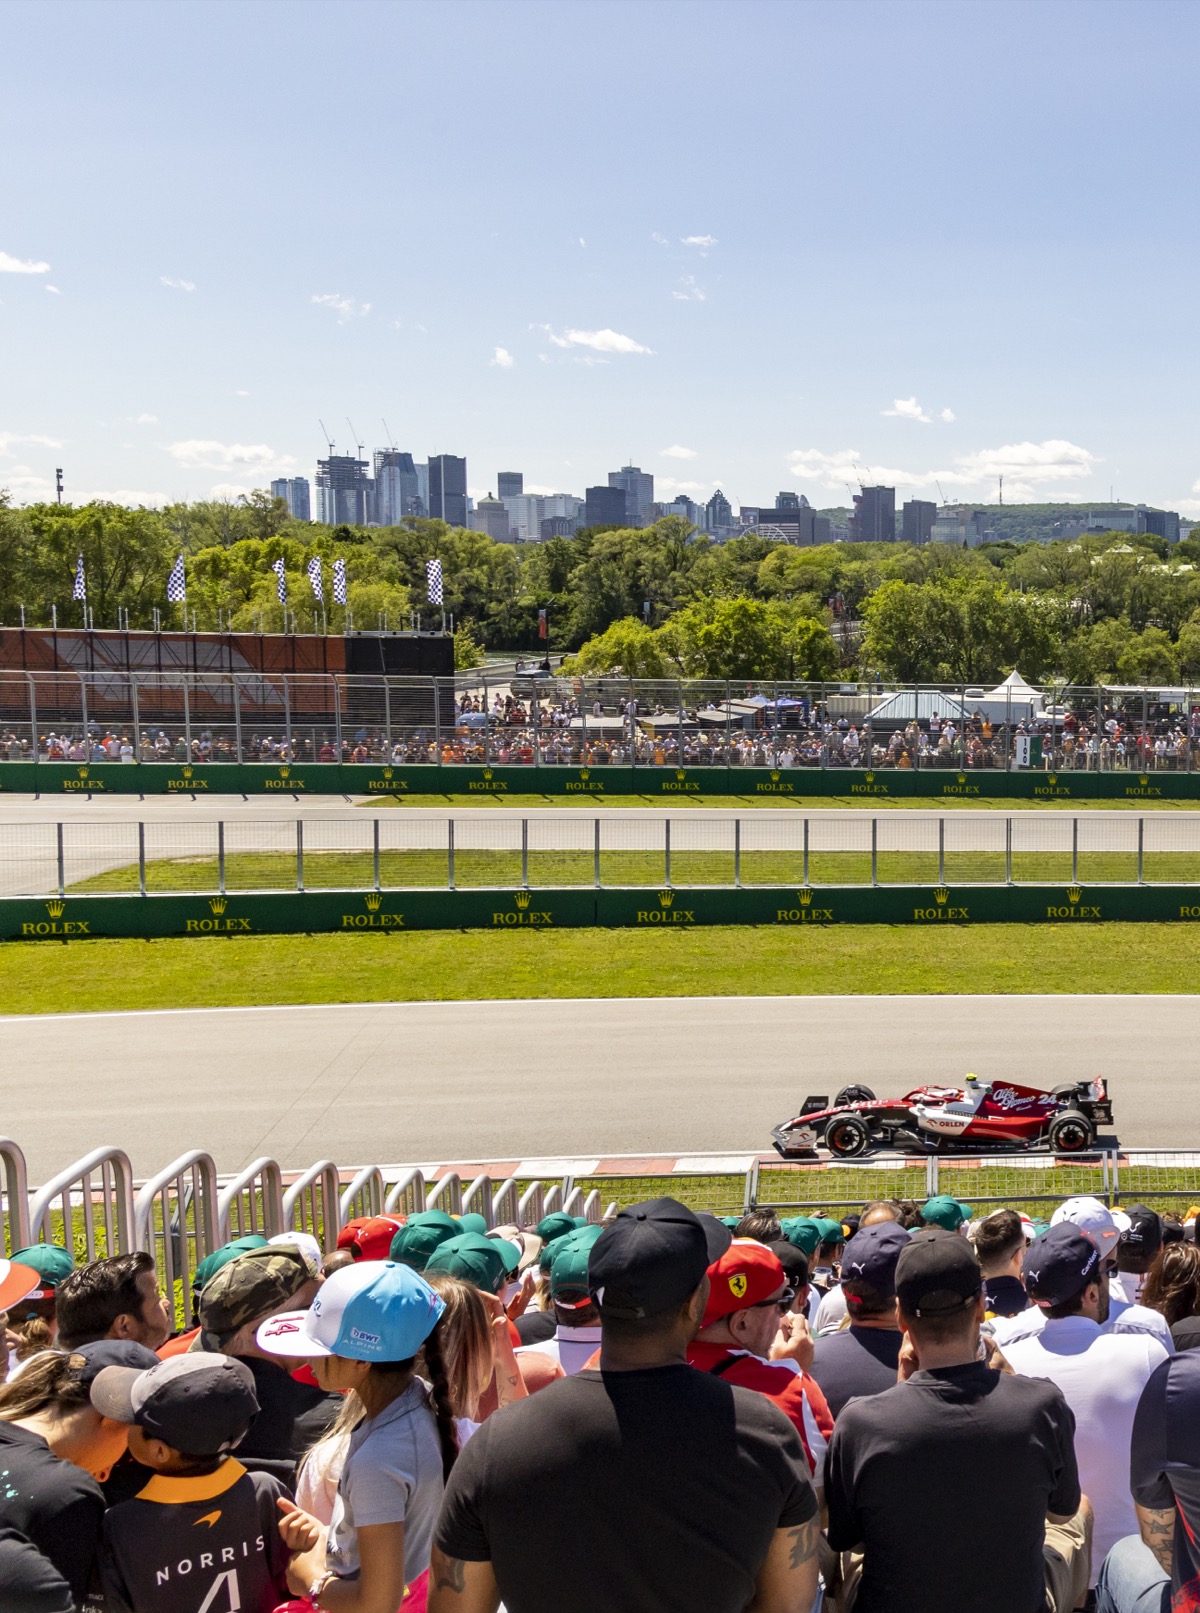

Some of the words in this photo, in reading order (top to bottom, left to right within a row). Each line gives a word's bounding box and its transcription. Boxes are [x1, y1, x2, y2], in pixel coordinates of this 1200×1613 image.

[63, 781, 104, 789] ROLEX
[167, 780, 208, 789] ROLEX
[264, 780, 305, 789] ROLEX
[368, 781, 408, 789] ROLEX
[469, 782, 508, 790] ROLEX
[662, 783, 700, 791] ROLEX
[756, 784, 794, 792] ROLEX
[851, 785, 888, 793] ROLEX
[1034, 787, 1070, 795] ROLEX
[637, 910, 695, 923] ROLEX
[777, 909, 833, 921] ROLEX
[913, 907, 969, 920] ROLEX
[1047, 906, 1101, 918] ROLEX
[342, 914, 404, 927] ROLEX
[492, 912, 553, 925] ROLEX
[21, 921, 91, 935] ROLEX
[186, 918, 252, 932] ROLEX
[1037, 1094, 1058, 1105] 24
[264, 1316, 305, 1337] 14
[358, 1332, 380, 1344] BWT
[341, 1338, 383, 1352] ALPINE
[156, 1534, 265, 1586] NORRIS
